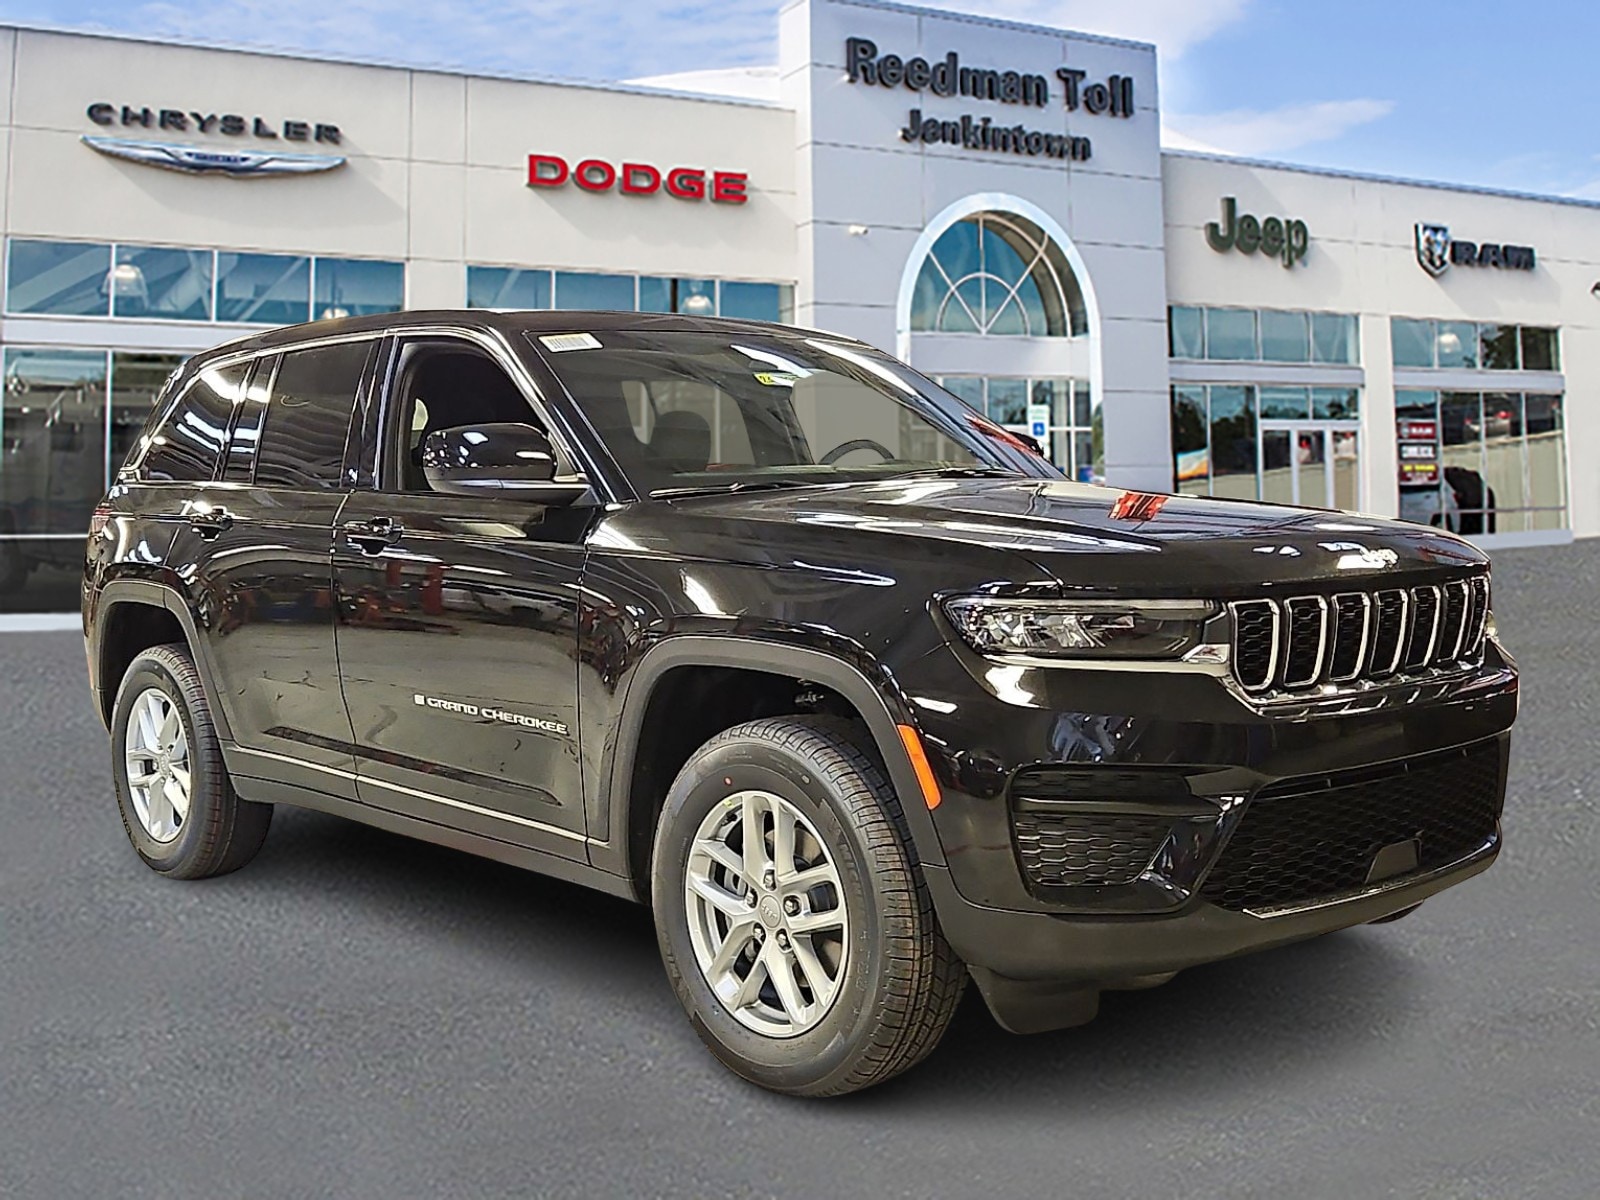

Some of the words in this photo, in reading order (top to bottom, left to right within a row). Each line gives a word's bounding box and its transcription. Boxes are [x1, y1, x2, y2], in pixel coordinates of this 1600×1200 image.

[846, 37, 1049, 108] Reedman
[1056, 67, 1135, 119] Toll
[86, 102, 341, 145] CHRYSLER
[901, 109, 1092, 161] Jenkintown
[526, 153, 748, 204] DODGE
[1205, 197, 1308, 269] Jeep
[1449, 240, 1536, 271] RAM
[427, 697, 478, 715] GRAND
[481, 708, 568, 735] CHEROKEE
